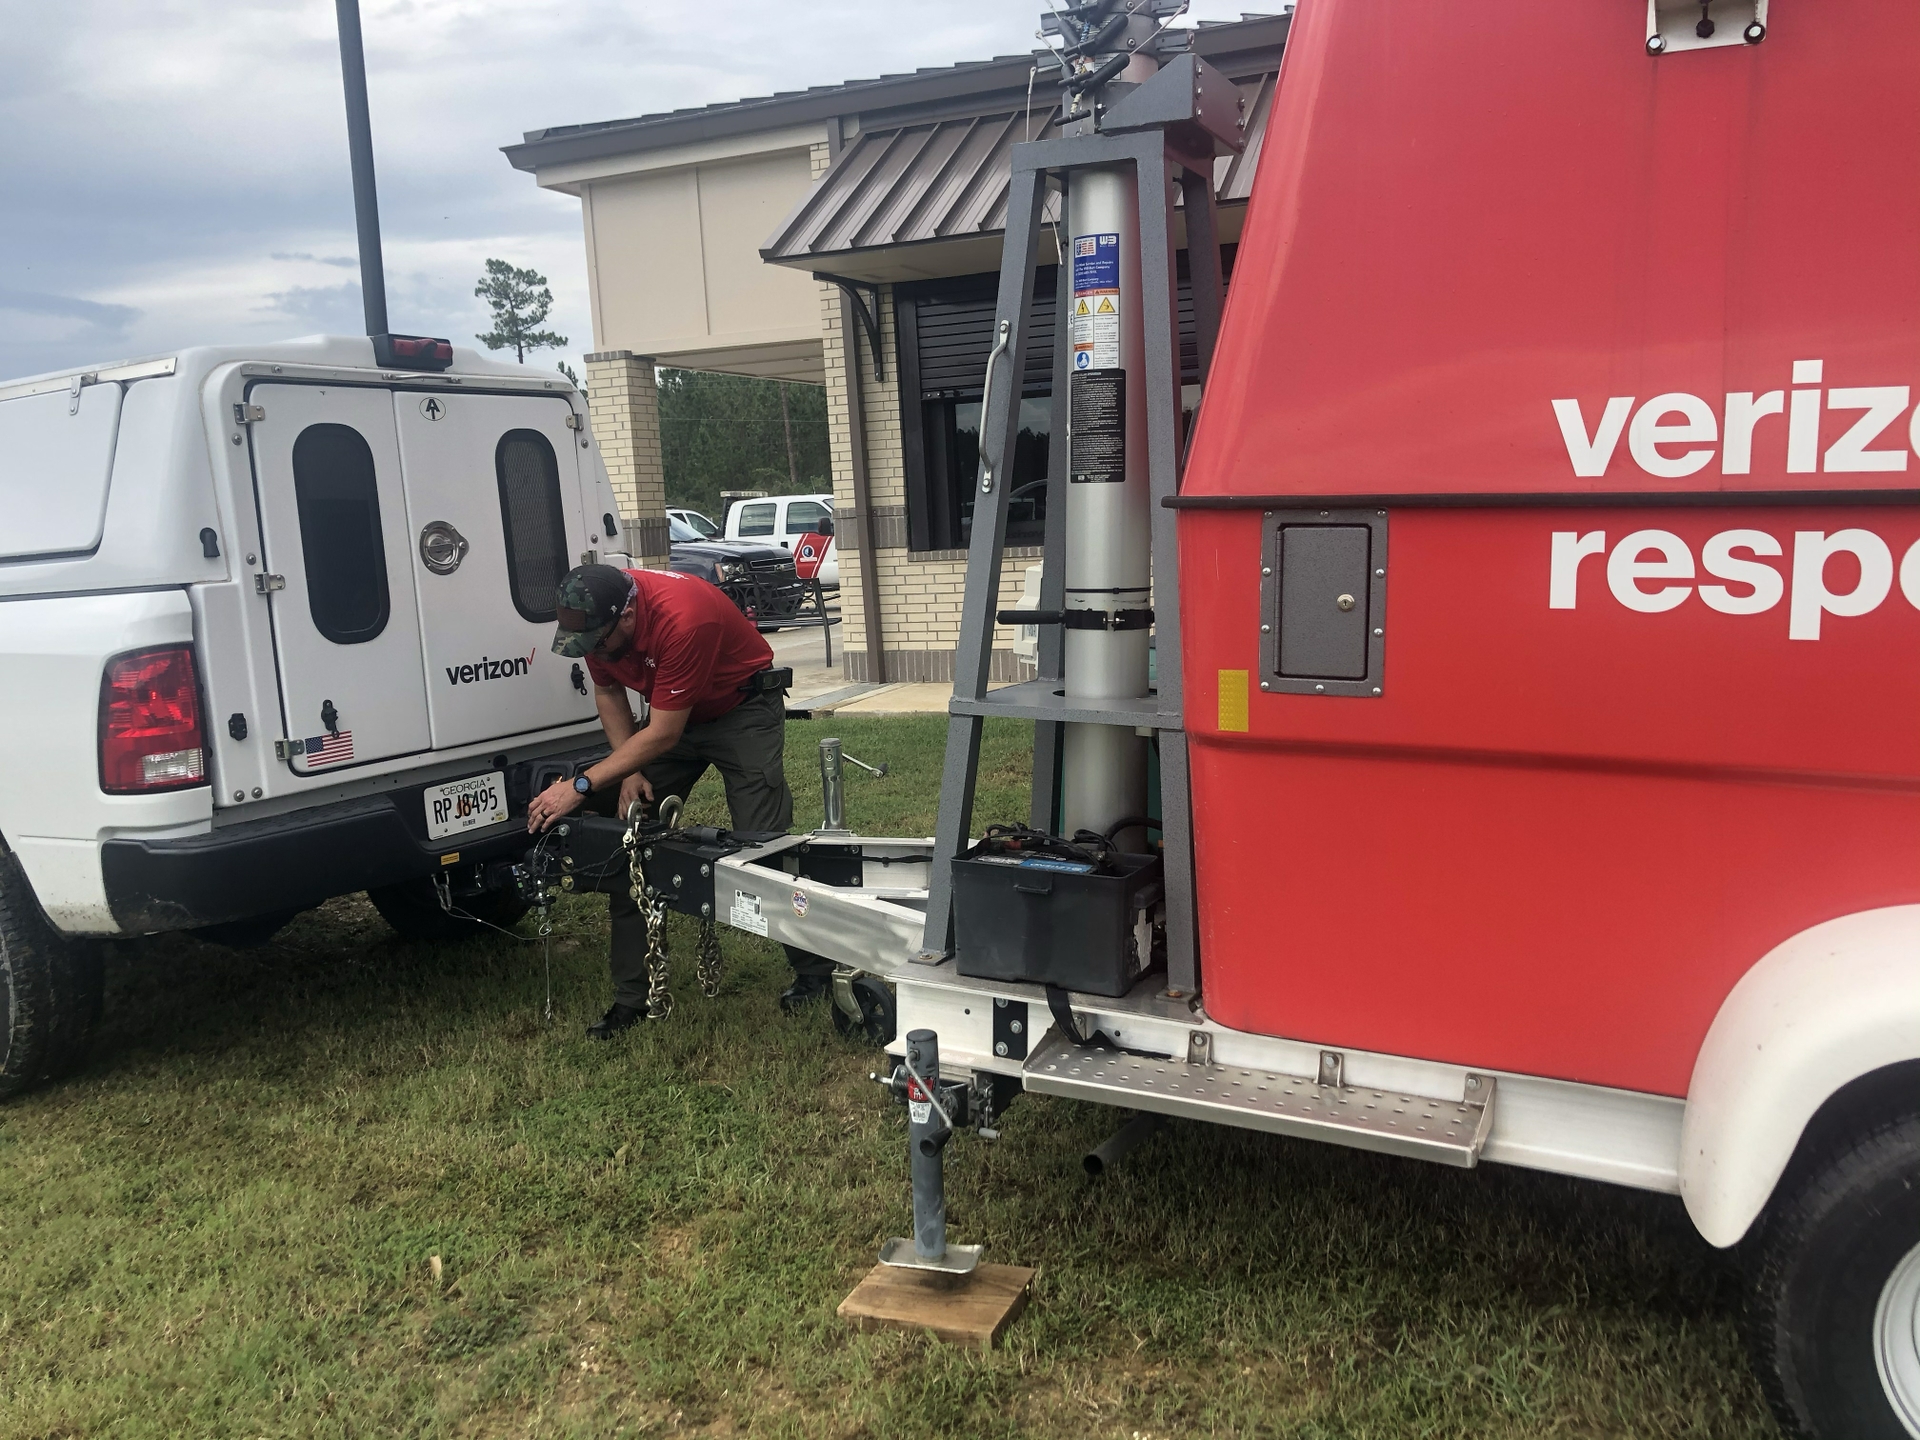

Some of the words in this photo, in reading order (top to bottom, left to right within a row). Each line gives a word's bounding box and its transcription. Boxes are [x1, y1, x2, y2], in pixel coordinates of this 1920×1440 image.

[1551, 359, 1920, 478] veriz
[1549, 528, 1920, 640] resp
[445, 656, 528, 685] verizon
[442, 779, 486, 796] GEORGIA
